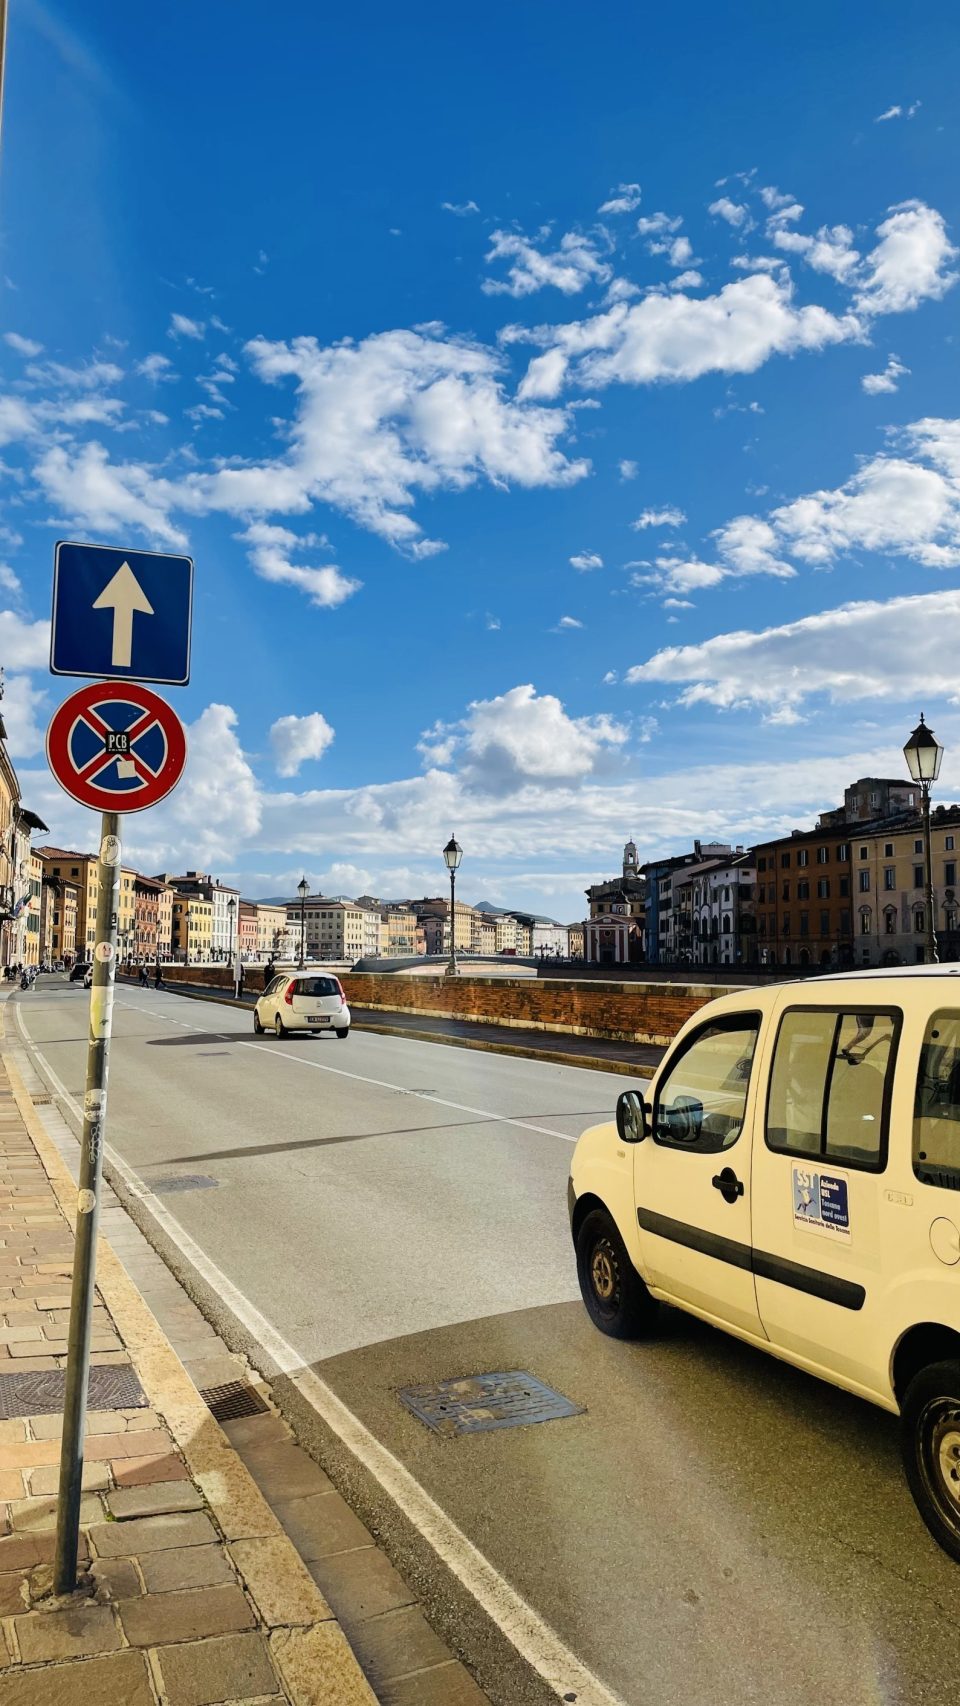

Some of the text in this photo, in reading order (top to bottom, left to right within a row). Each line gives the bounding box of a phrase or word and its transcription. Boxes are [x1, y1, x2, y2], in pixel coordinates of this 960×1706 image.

[108, 734, 127, 749] PCB
[797, 1169, 816, 1189] SST
[820, 1188, 831, 1198] USL
[821, 1198, 841, 1210] Toscana
